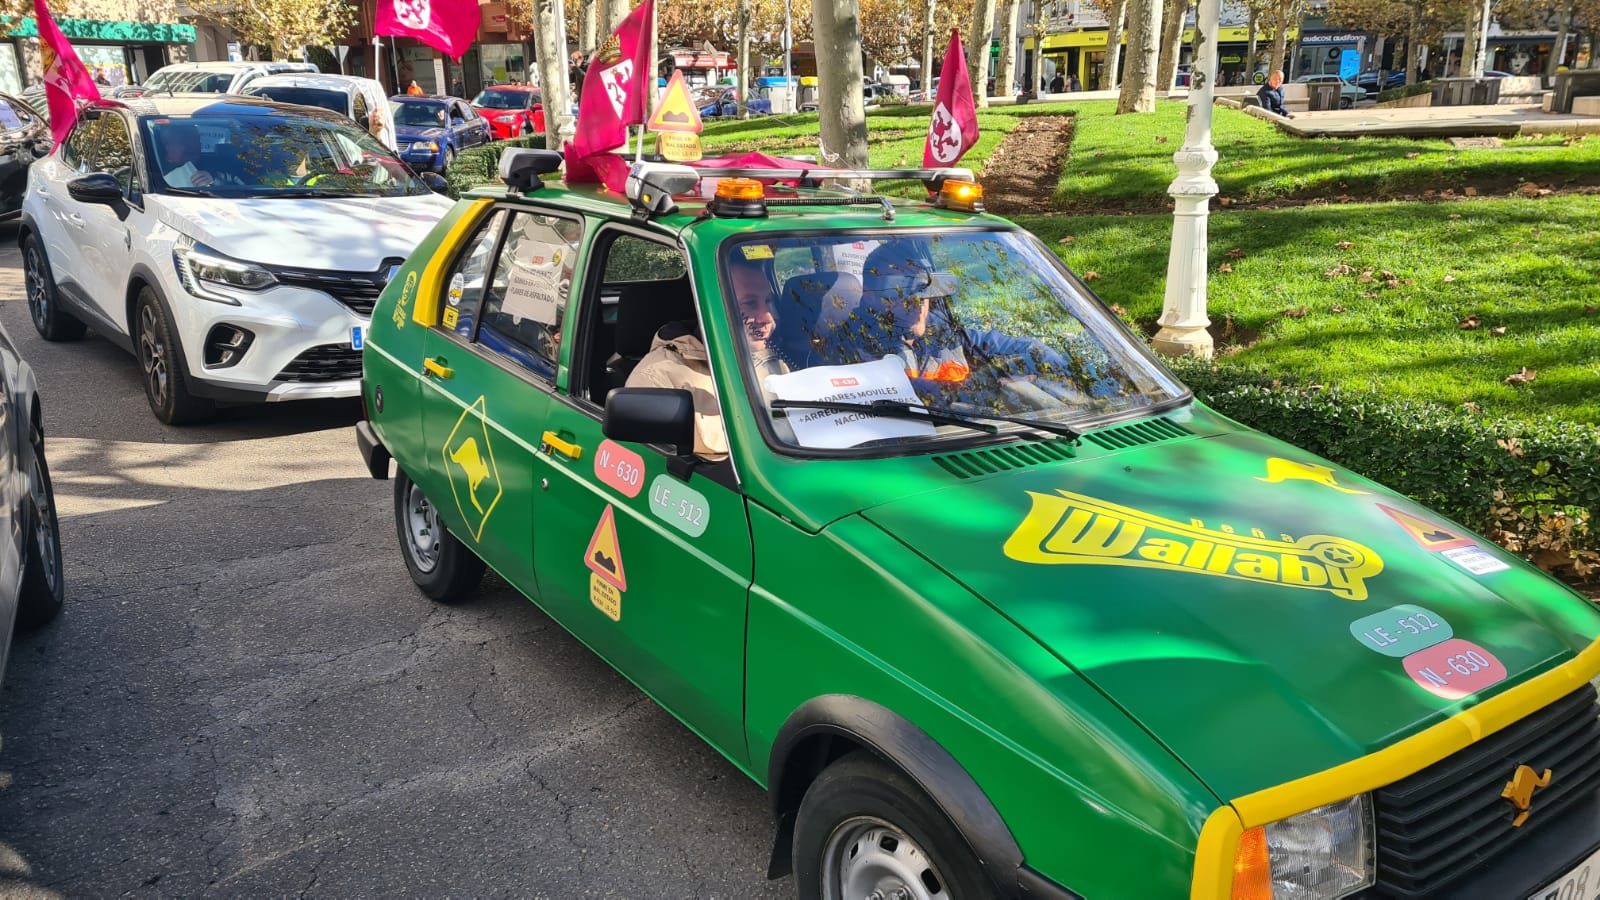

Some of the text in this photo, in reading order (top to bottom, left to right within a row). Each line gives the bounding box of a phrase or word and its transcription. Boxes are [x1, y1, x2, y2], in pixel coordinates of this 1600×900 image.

[857, 387, 898, 400] MOVILES
[599, 449, 610, 468] N
[616, 460, 639, 486] 630
[654, 484, 671, 508] LE
[678, 499, 703, 526] 512
[1045, 505, 1368, 601] Wallaby
[1363, 626, 1398, 647] LE
[1398, 613, 1439, 635] 512
[1418, 666, 1449, 688] N
[1447, 650, 1490, 676] 630
